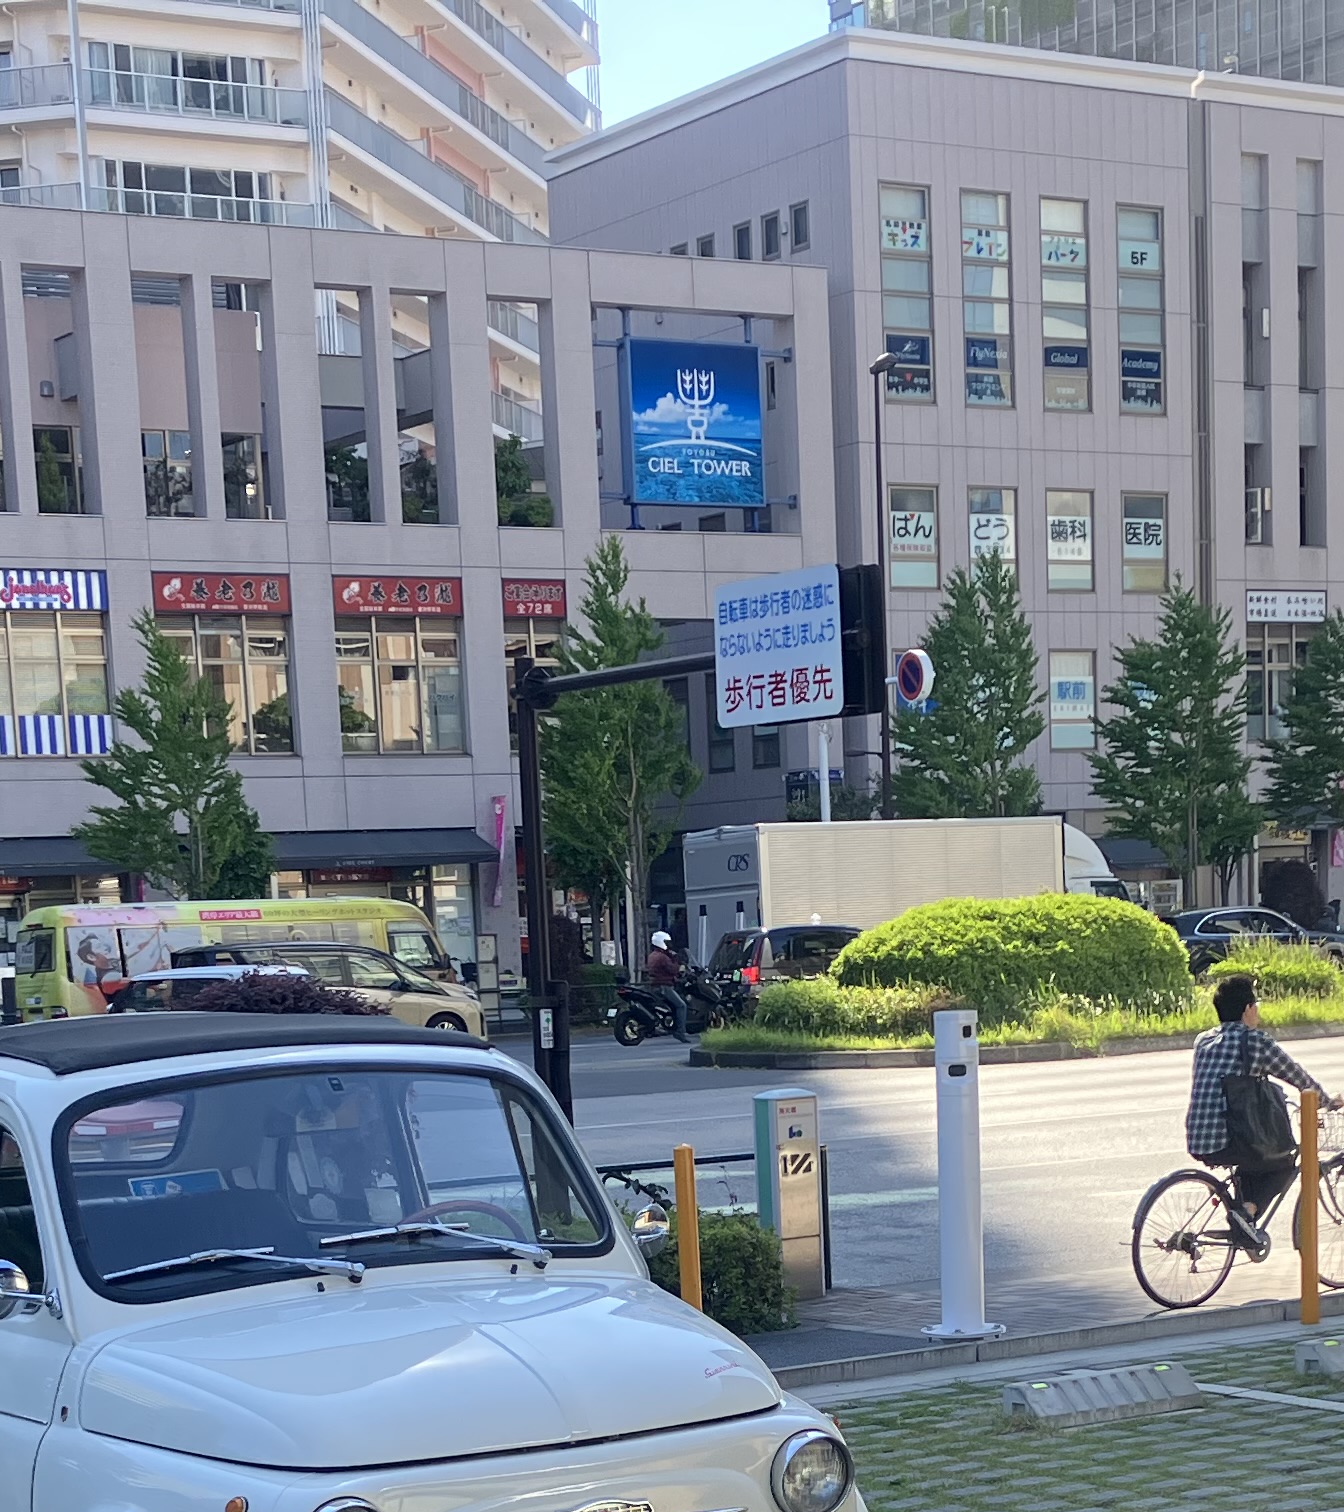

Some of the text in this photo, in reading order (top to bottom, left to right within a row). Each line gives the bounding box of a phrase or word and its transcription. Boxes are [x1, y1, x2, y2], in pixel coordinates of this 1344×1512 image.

[887, 229, 921, 248] キッズ
[1047, 245, 1080, 263] パーク
[1130, 250, 1148, 266] 5F
[1050, 353, 1079, 365] Global
[1122, 357, 1159, 373] Academy
[647, 456, 752, 477] CIEL TOWER
[892, 513, 933, 539] ばん
[974, 517, 1010, 541] どう
[1050, 518, 1088, 543] 歯科
[1124, 520, 1163, 546] 医院
[719, 583, 834, 625] 自転車は歩行者の迷惑に
[719, 618, 836, 658] ならないように走りましょう
[725, 663, 834, 713] 歩行者優先
[1057, 680, 1087, 701] 駅前
[727, 853, 750, 872] CRS
